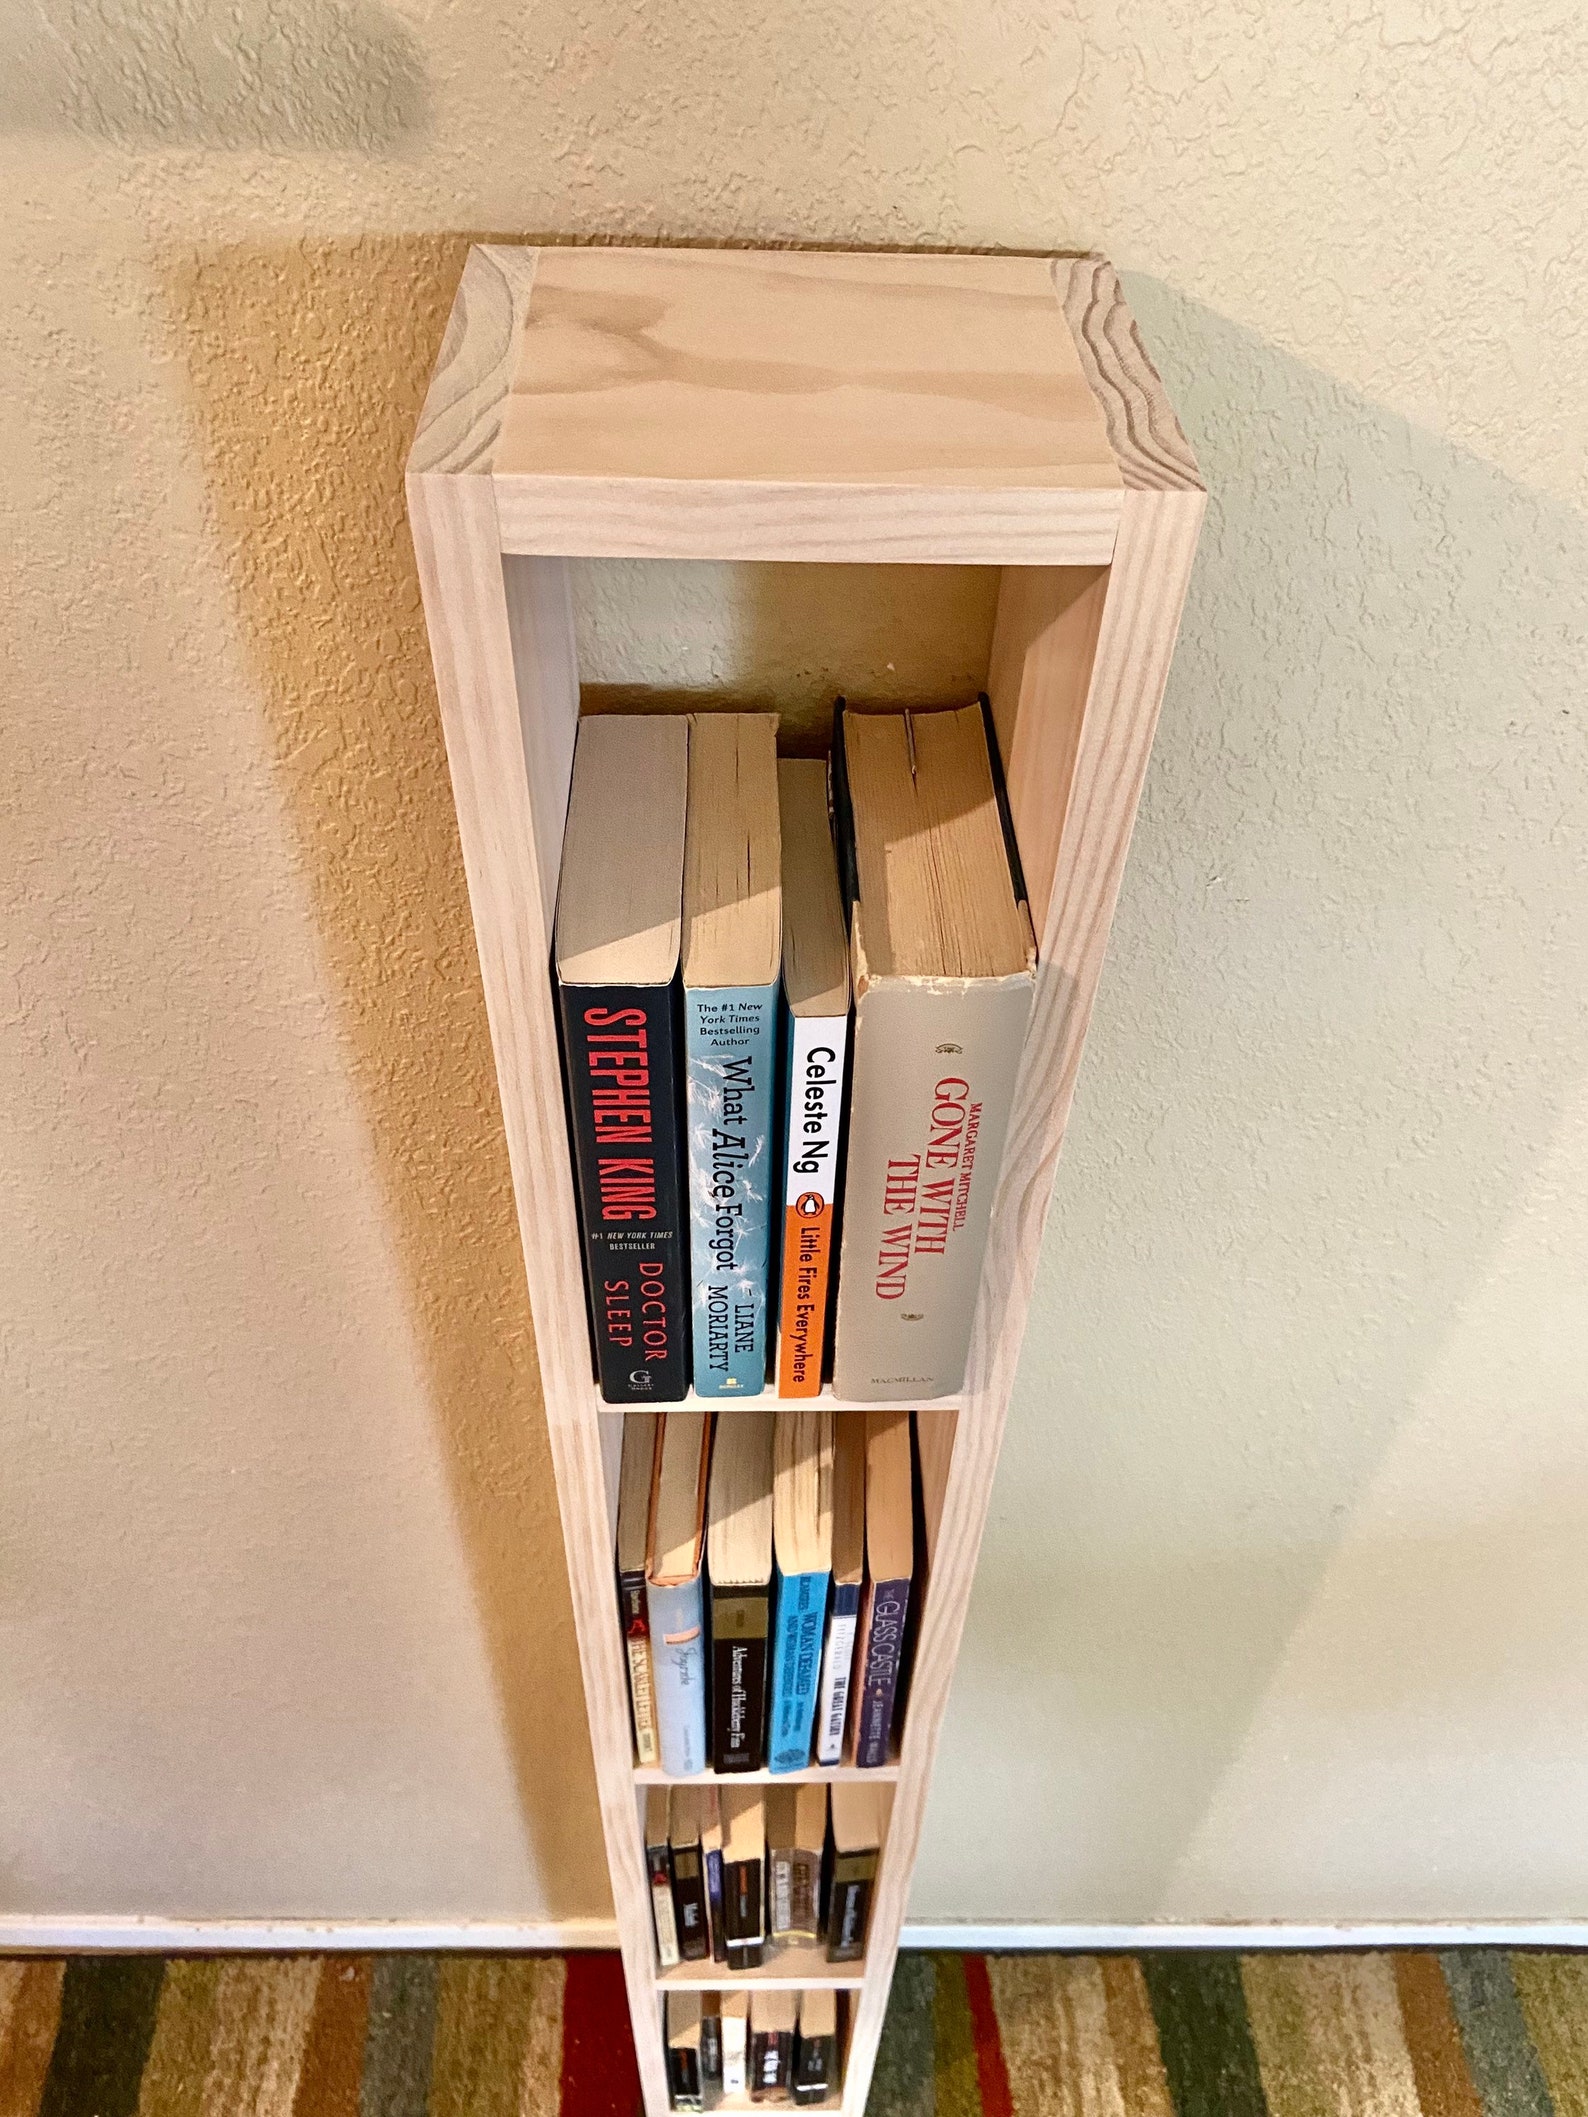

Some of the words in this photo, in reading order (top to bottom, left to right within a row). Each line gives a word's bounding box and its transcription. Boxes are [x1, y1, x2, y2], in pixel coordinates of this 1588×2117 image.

[697, 1004, 718, 1012] The
[721, 1003, 734, 1011] #1
[738, 1002, 763, 1011] New
[700, 1015, 725, 1024] York
[728, 1014, 760, 1023] Times
[700, 1026, 760, 1036] Bestselling
[710, 1038, 750, 1046] Author
[584, 1007, 653, 1143] STEPHEN
[722, 1056, 755, 1125] What
[803, 1047, 837, 1134] Celeste
[925, 1077, 970, 1169] GONE
[961, 1102, 983, 1170] MARGARET
[712, 1128, 749, 1198] Alice
[793, 1140, 830, 1173] Ng
[883, 1154, 921, 1215] THE
[598, 1158, 657, 1220] KING
[914, 1177, 955, 1254] WITH
[952, 1172, 973, 1232] MITCHELL
[607, 1231, 625, 1239] NEW
[709, 1203, 743, 1271] Forgot
[799, 1227, 820, 1262] Little
[875, 1224, 912, 1299] WIND
[604, 1280, 633, 1347] SLEEP
[639, 1262, 668, 1361] DOCTOR
[797, 1267, 817, 1300] Fires
[708, 1285, 729, 1372] MORIARTY
[734, 1303, 755, 1353] LIANE
[789, 1304, 815, 1383] Everywhere
[872, 1601, 900, 1642] GLASS
[834, 1677, 847, 1690] THE
[867, 1643, 896, 1686] CASTLE
[829, 1713, 844, 1736] GATSBY
[831, 1691, 845, 1712] GREAT
